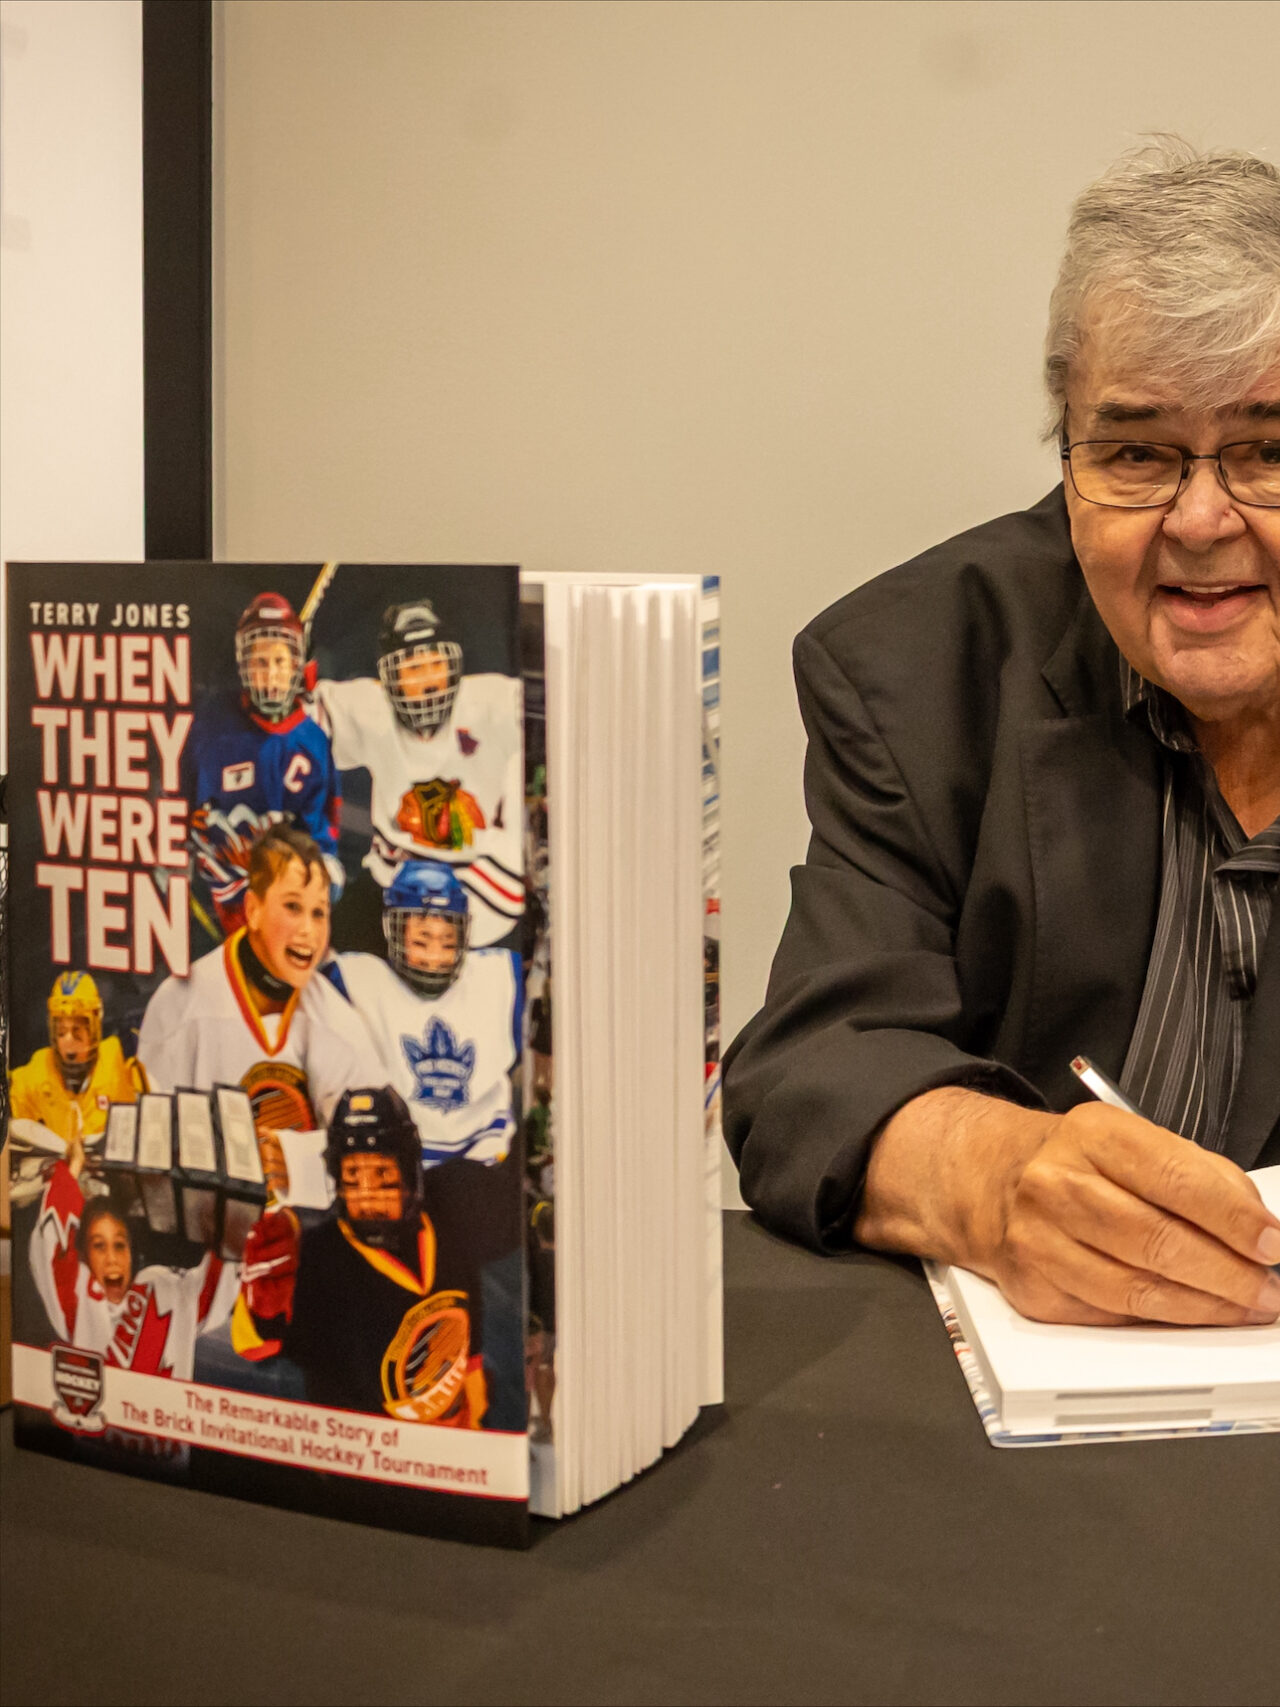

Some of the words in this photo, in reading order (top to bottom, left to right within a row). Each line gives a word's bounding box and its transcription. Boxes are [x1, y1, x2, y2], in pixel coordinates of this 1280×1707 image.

[30, 602, 99, 626] TERRY
[110, 603, 190, 628] JONES
[30, 632, 191, 706] WHEN
[31, 705, 194, 792] THEY
[36, 789, 190, 867] WERE
[35, 862, 192, 978] TEN
[122, 1401, 149, 1424] The
[154, 1408, 196, 1435] Brick
[200, 1418, 295, 1454] Invitational
[301, 1438, 365, 1470] Hockey
[371, 1451, 489, 1485] Tournament
[184, 1390, 213, 1413] The
[219, 1397, 320, 1433] Remarkable
[325, 1417, 375, 1448] Story
[381, 1428, 399, 1447] of
